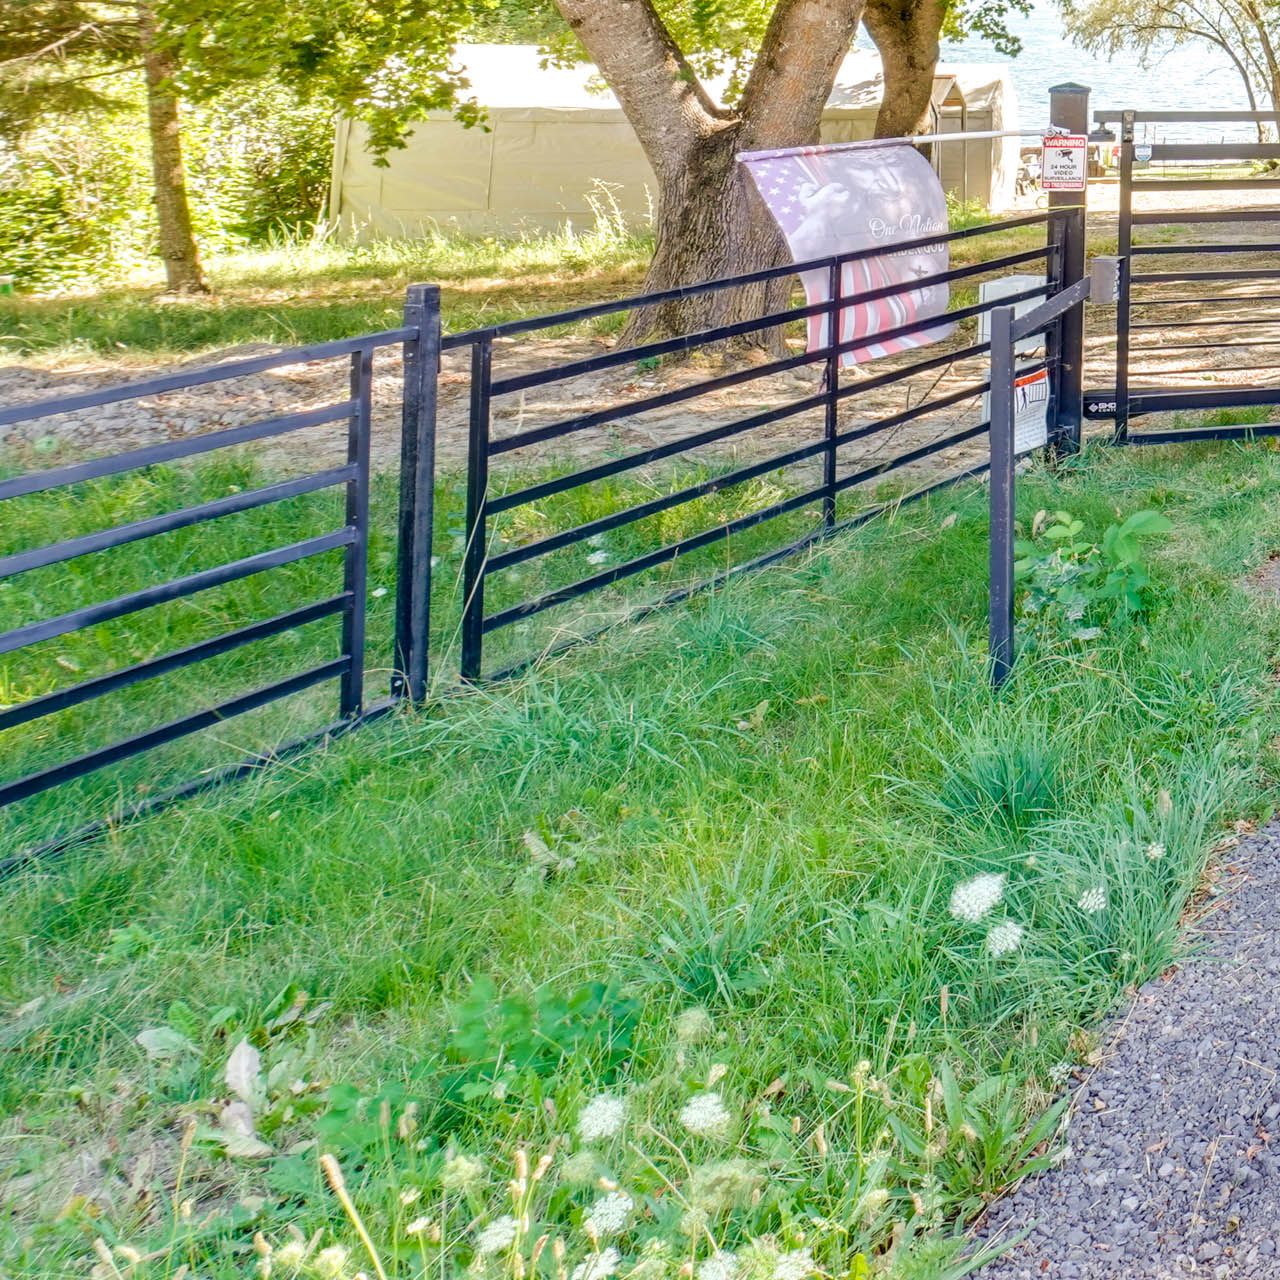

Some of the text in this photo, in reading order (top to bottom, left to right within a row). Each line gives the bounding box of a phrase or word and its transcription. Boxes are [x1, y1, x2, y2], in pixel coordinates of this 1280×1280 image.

[1045, 138, 1084, 146] WARNING
[868, 214, 945, 239] One Nation
